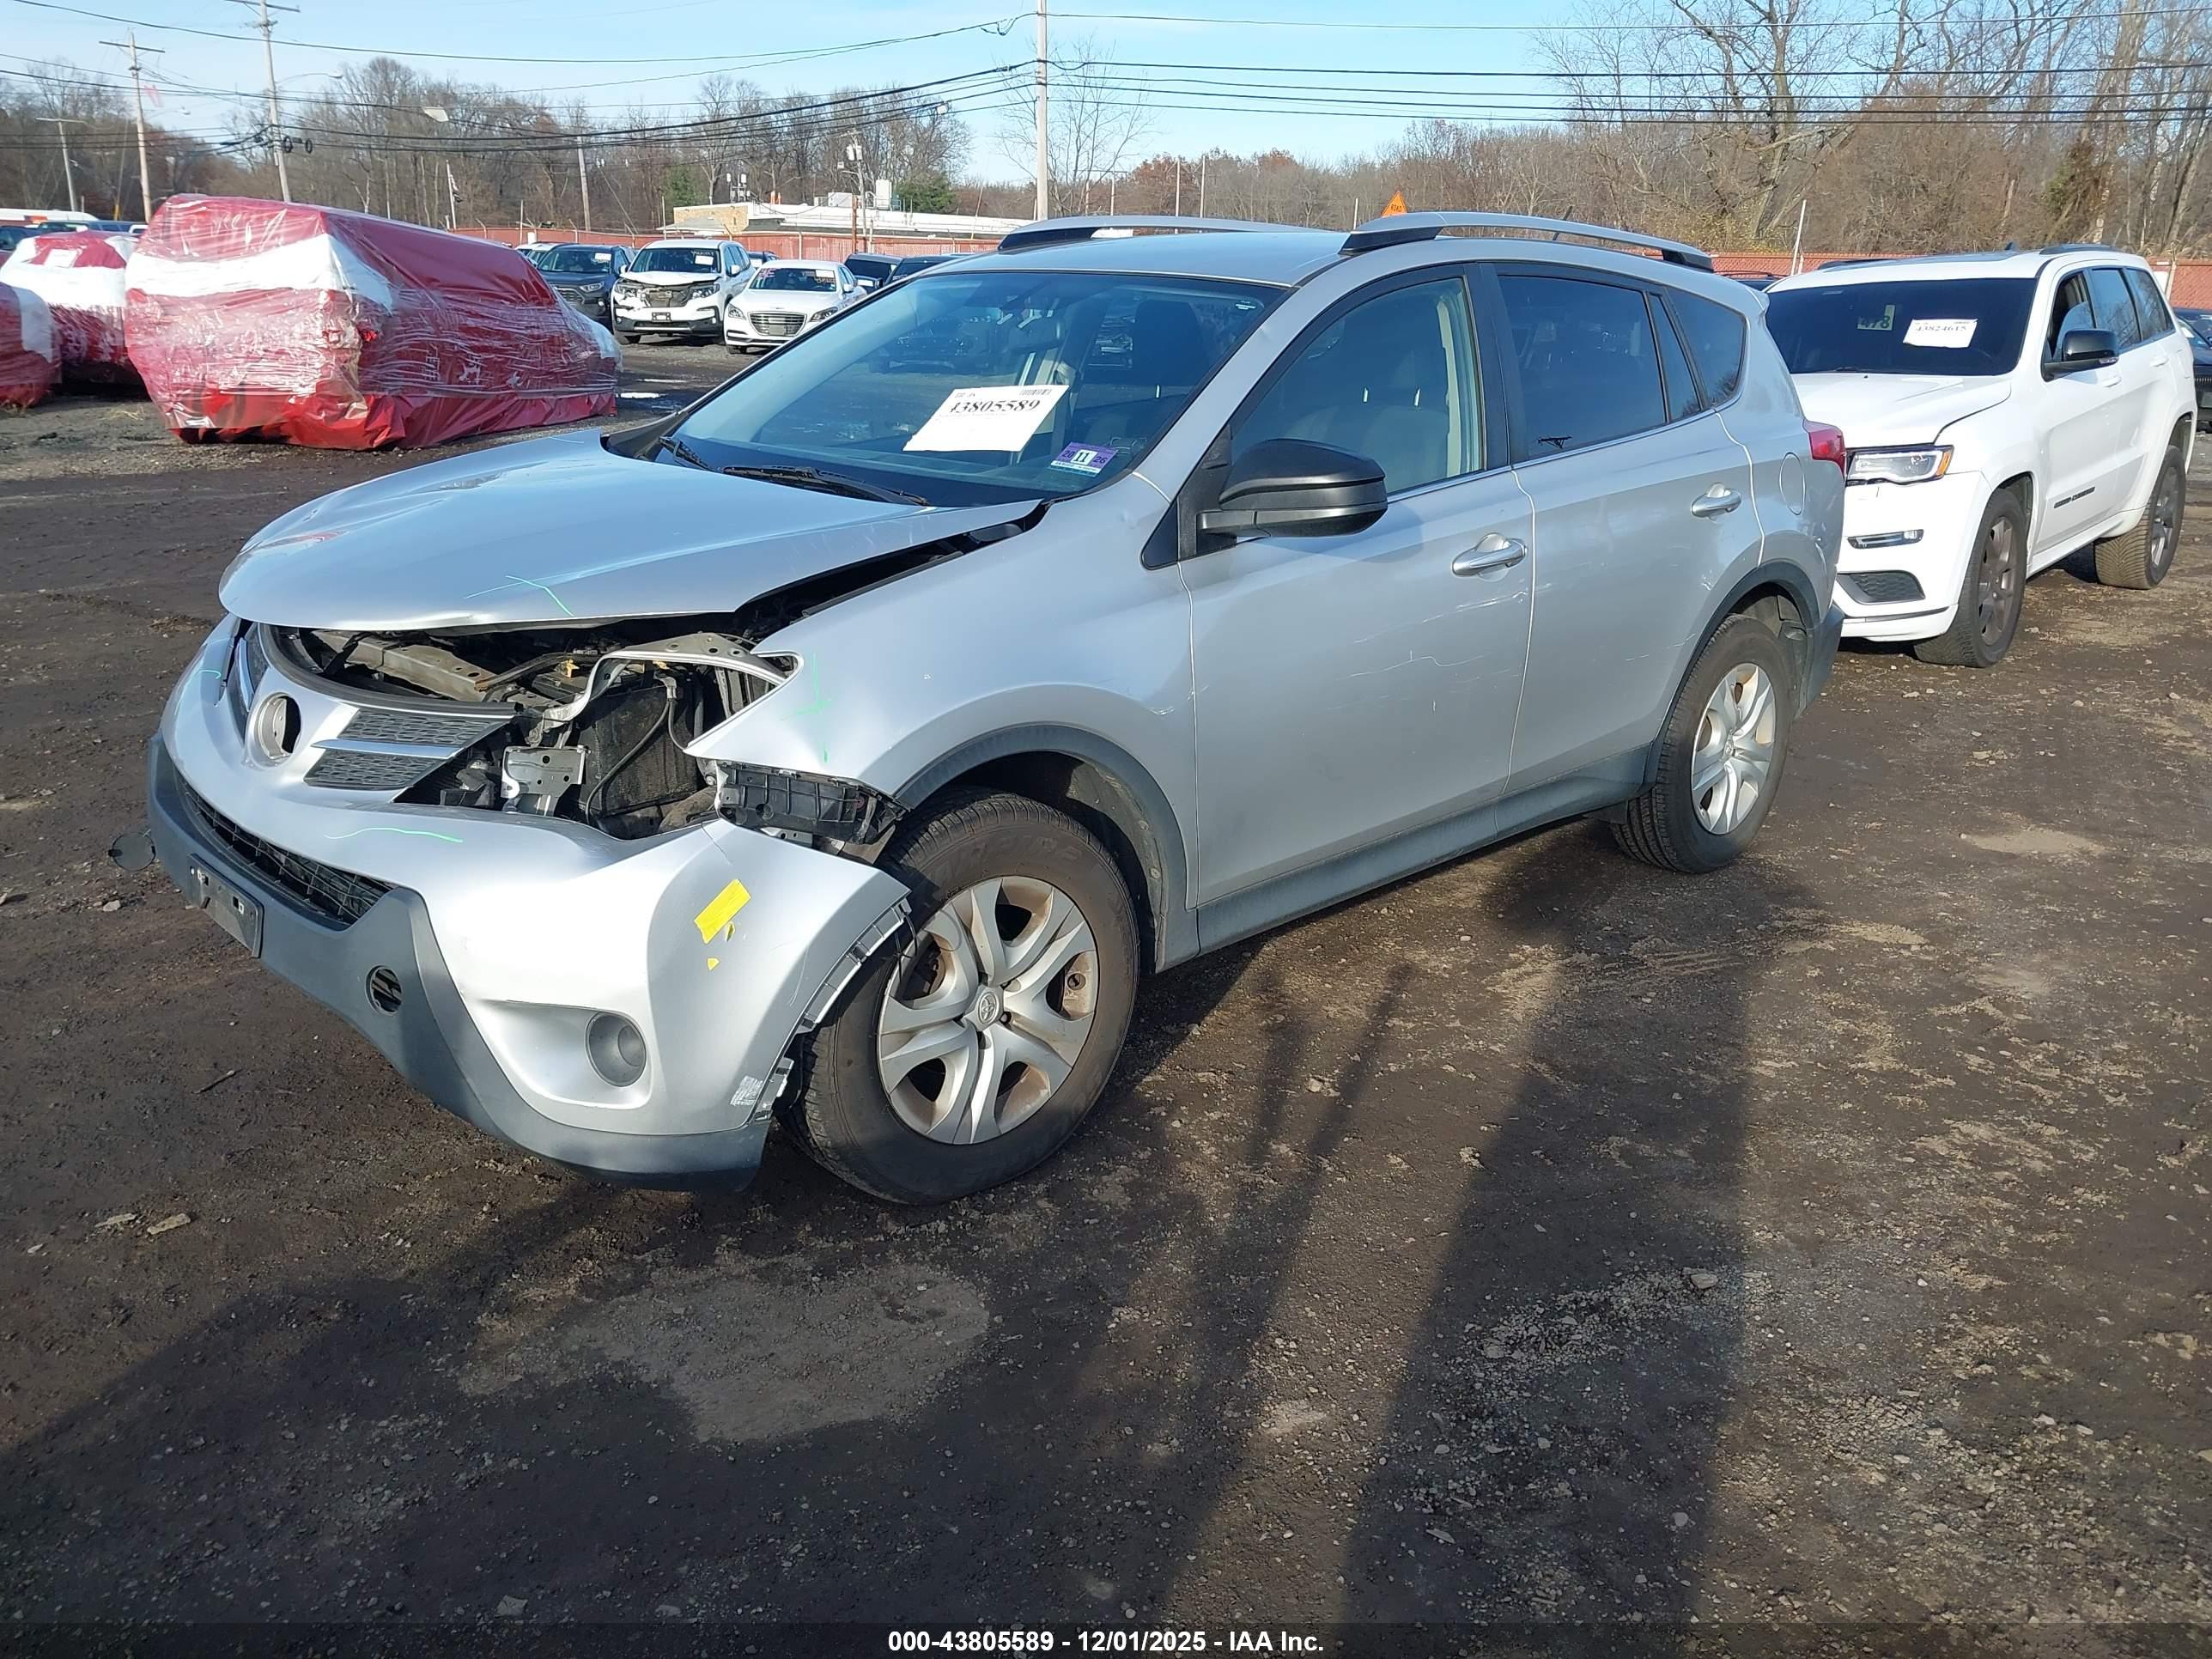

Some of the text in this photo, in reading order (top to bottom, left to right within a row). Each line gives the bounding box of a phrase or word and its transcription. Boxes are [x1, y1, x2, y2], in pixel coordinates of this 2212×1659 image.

[950, 398, 1041, 413] 43805589
[1062, 450, 1076, 459] 20
[1073, 452, 1090, 463] 11
